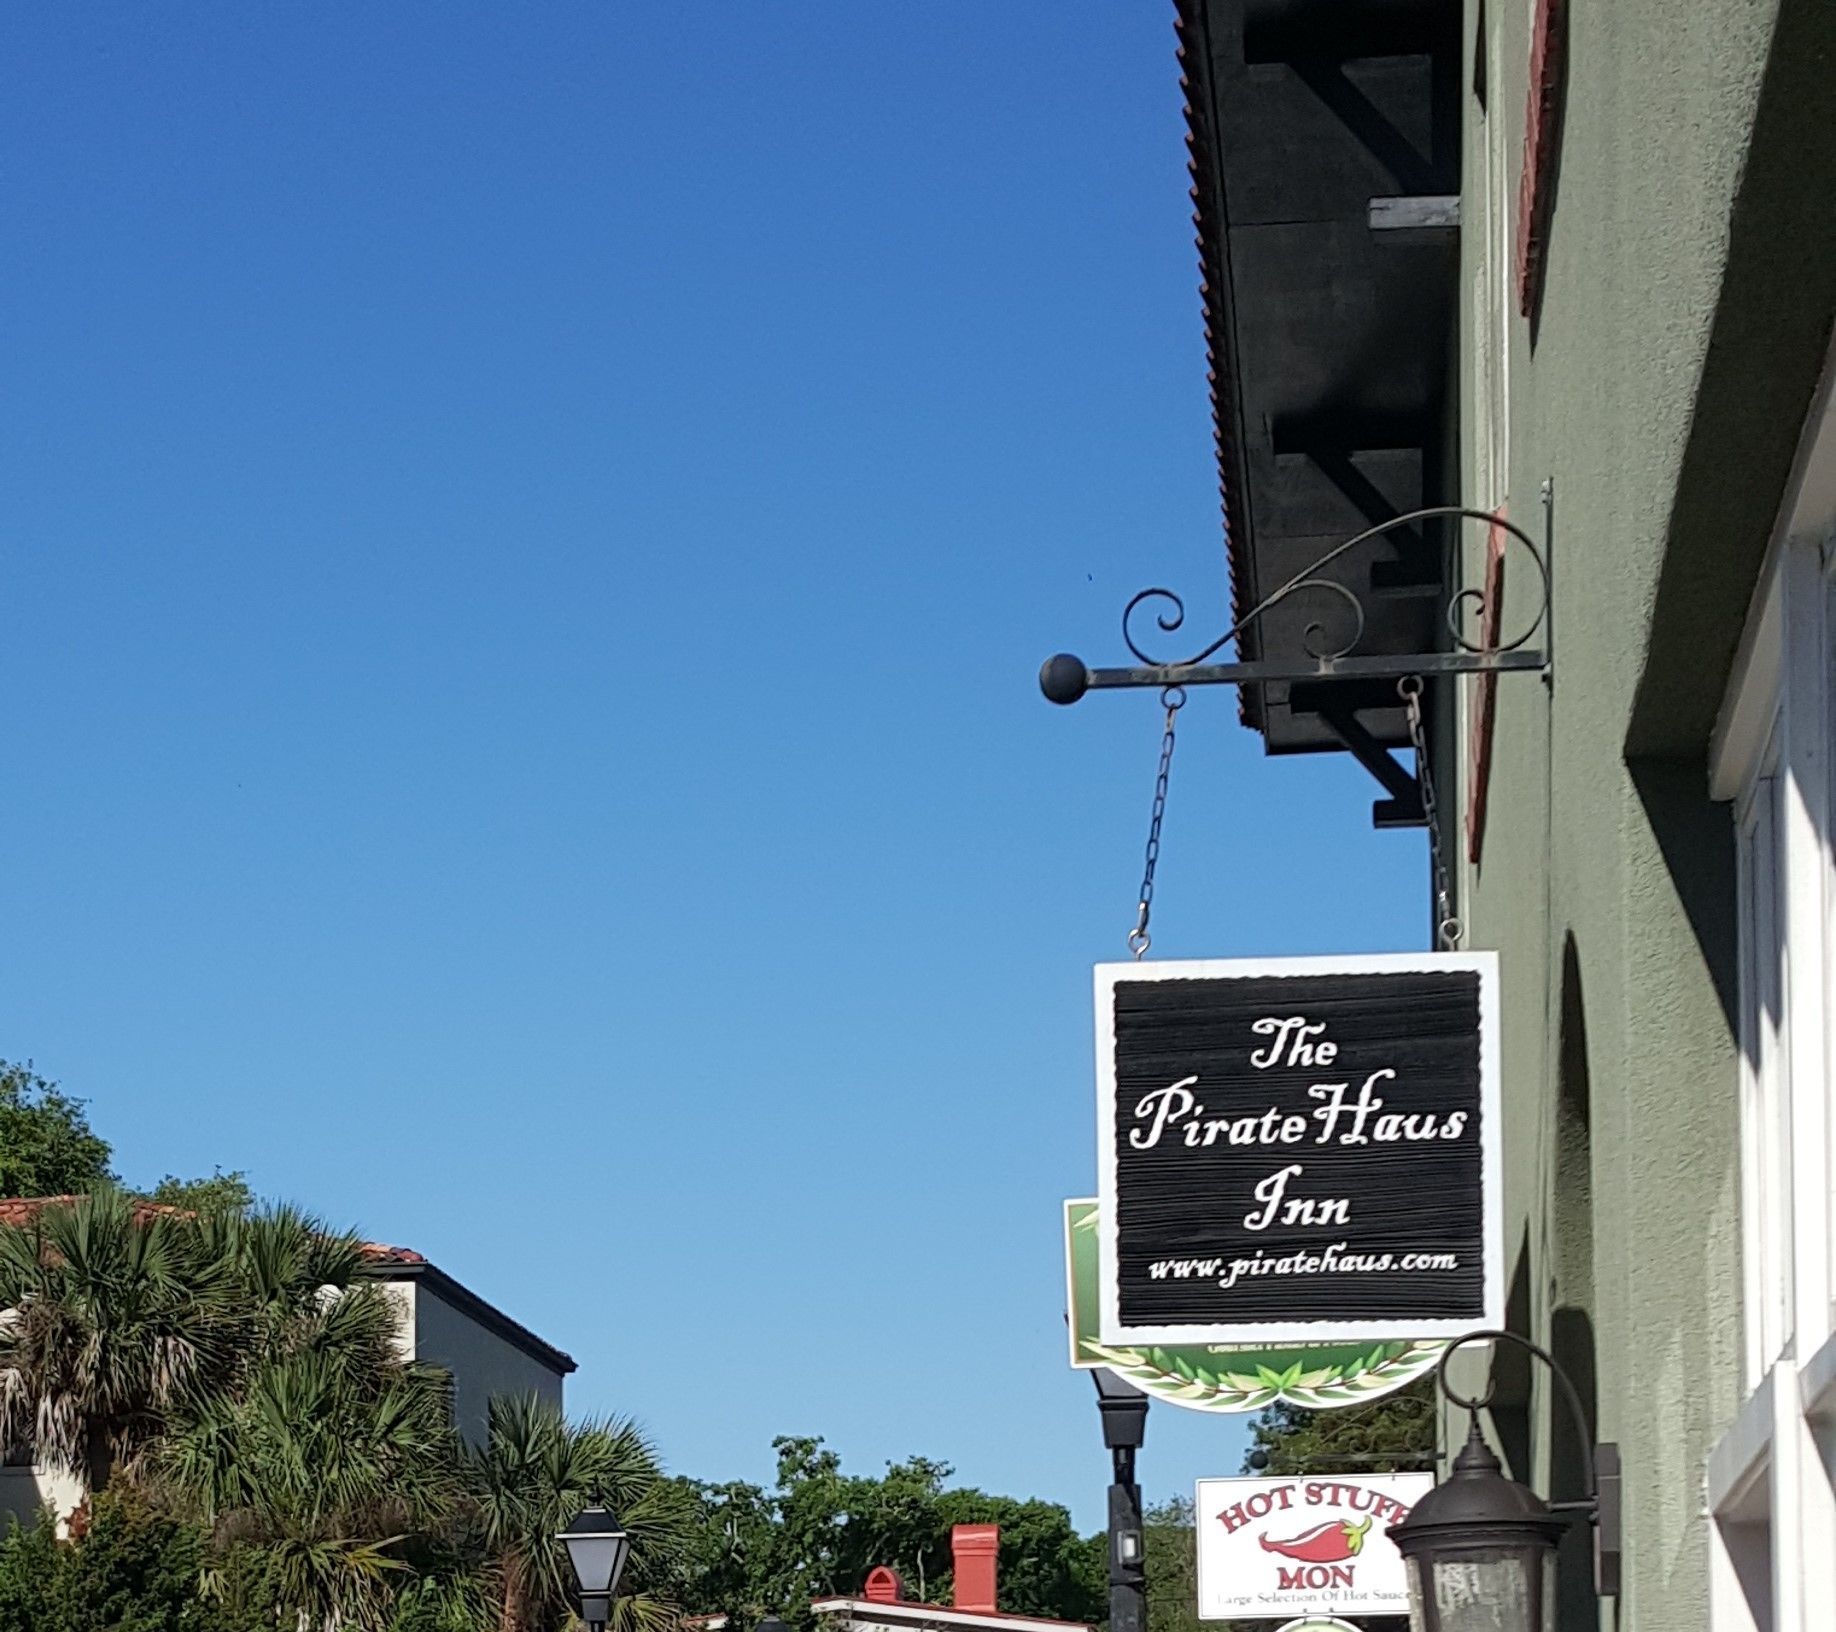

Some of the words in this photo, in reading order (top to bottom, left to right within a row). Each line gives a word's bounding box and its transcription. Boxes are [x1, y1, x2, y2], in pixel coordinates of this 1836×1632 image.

[1250, 1016, 1338, 1069] The
[1129, 1075, 1306, 1150] Pirate
[1308, 1069, 1469, 1145] Haus
[1243, 1165, 1351, 1231] Inn
[1148, 1242, 1458, 1289] www.piratehaus.com
[1216, 1485, 1296, 1534] HOT
[1257, 1592, 1317, 1604] Selection
[1321, 1590, 1340, 1601] Of
[1343, 1589, 1368, 1600] Hot
[1277, 1565, 1356, 1590] MON
